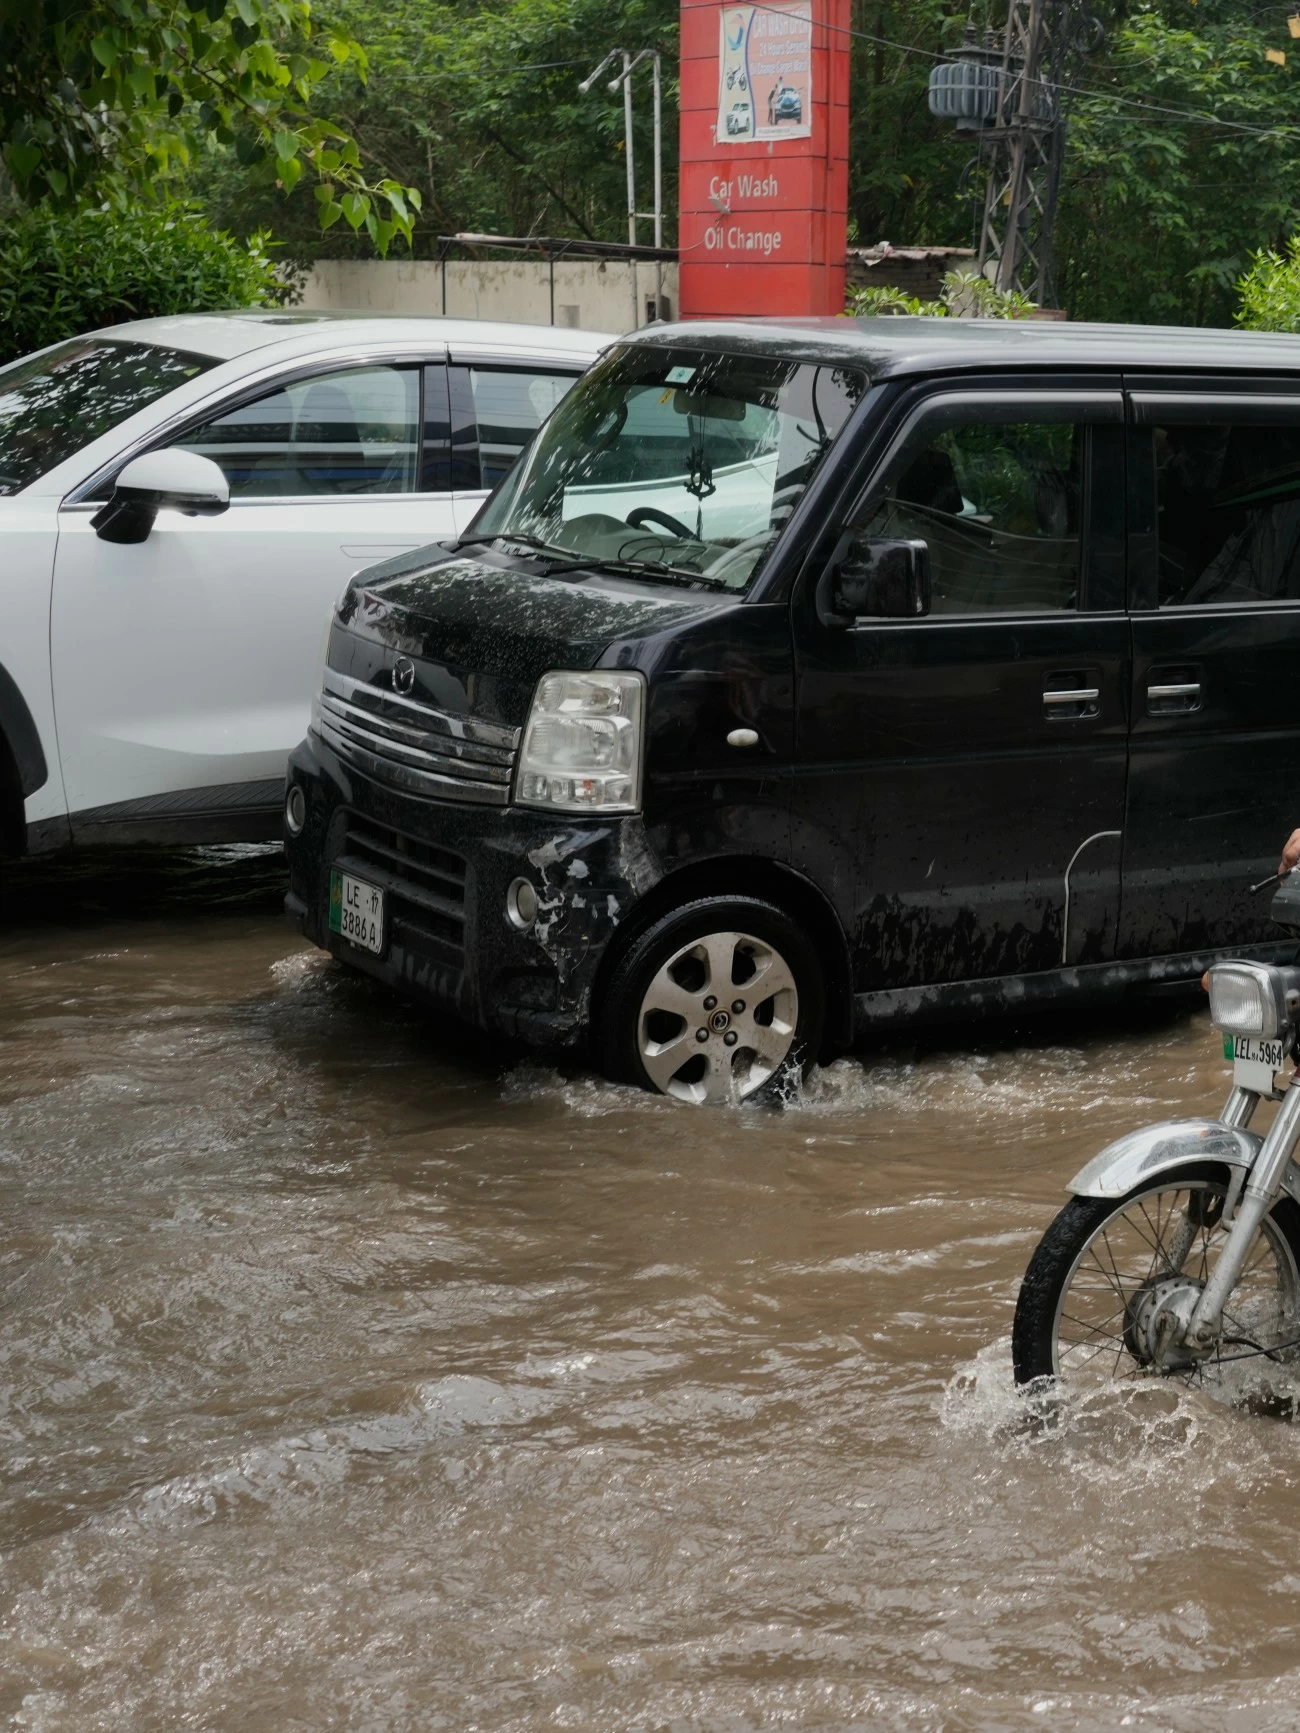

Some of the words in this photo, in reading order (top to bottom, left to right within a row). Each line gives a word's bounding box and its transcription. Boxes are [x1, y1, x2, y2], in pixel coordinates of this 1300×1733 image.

[709, 175, 733, 199] Car
[737, 174, 778, 198] Wash
[704, 226, 724, 250] Oil
[727, 226, 782, 256] Change
[346, 881, 360, 909] LE
[342, 907, 367, 940] 3886
[1259, 1041, 1282, 1067] 5964
